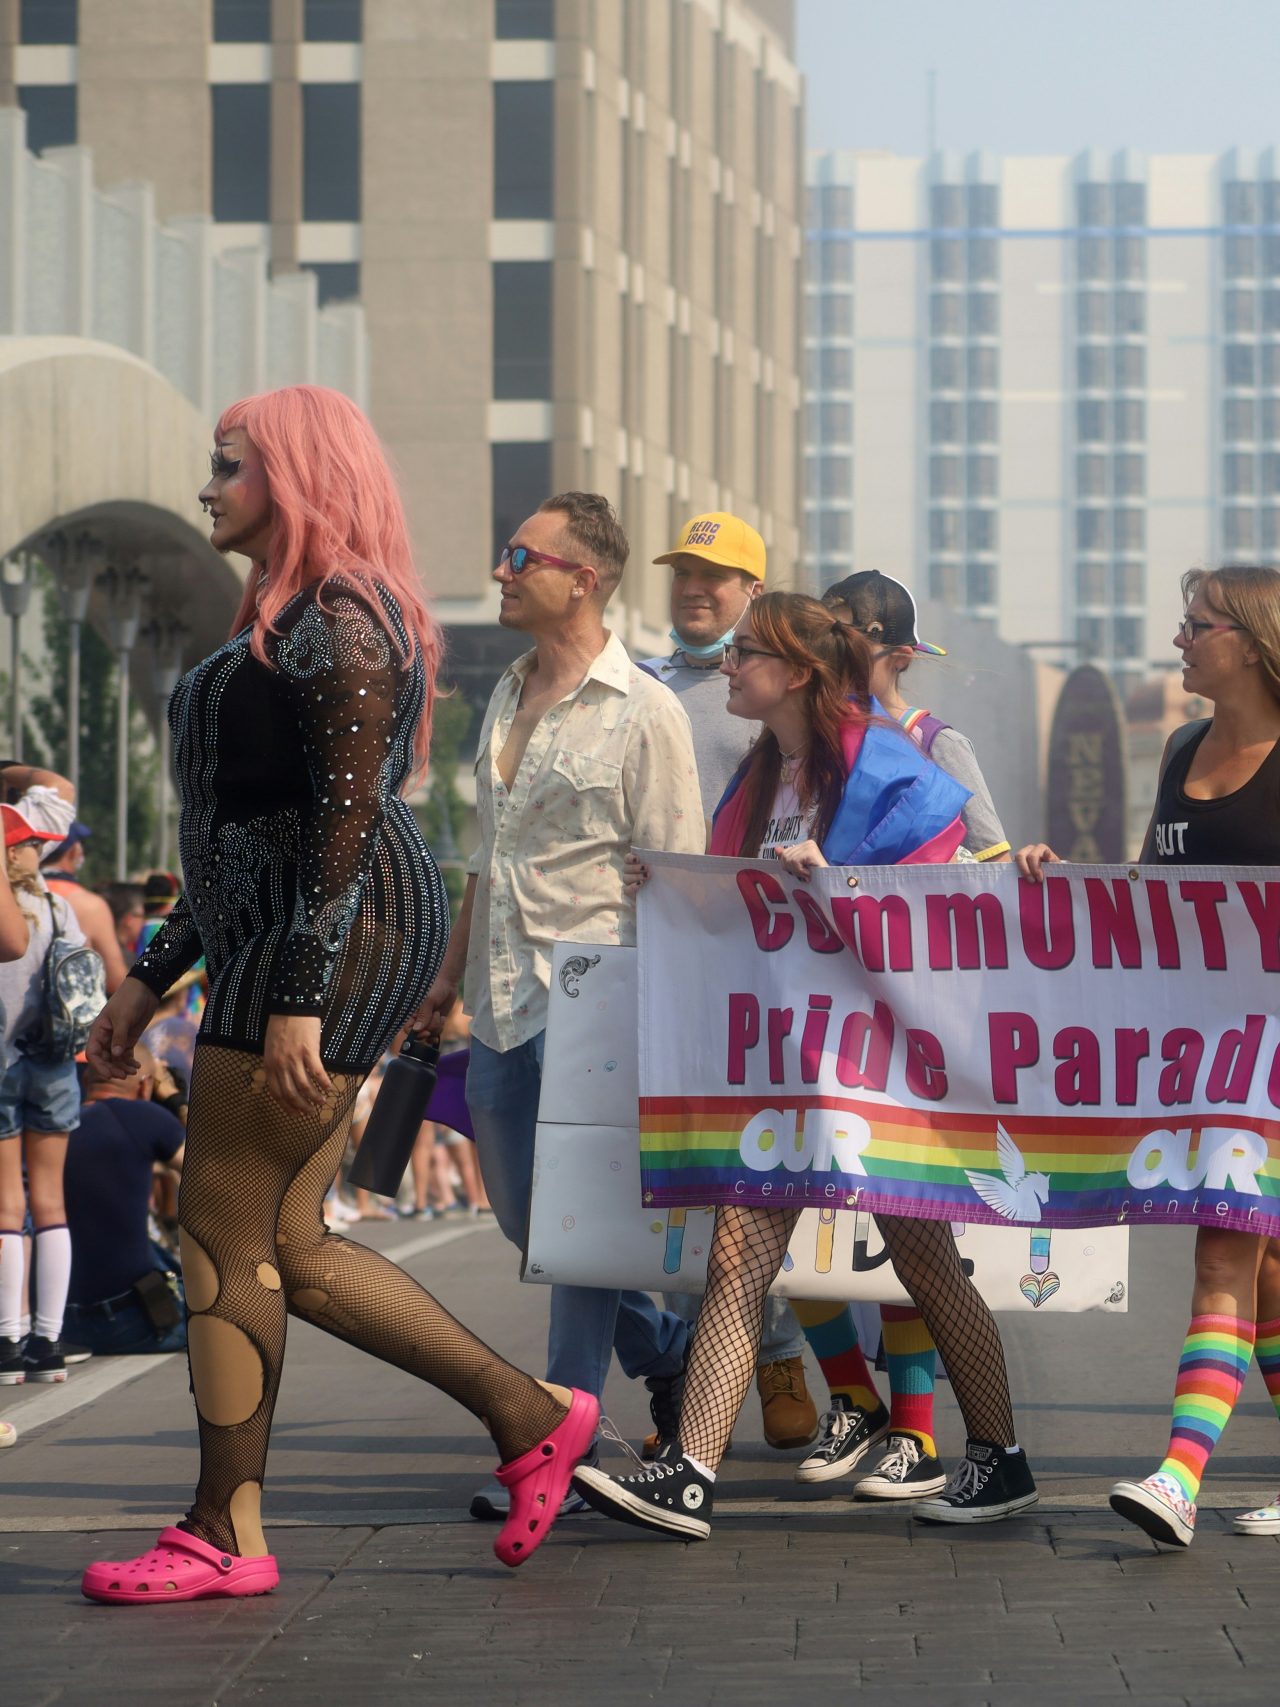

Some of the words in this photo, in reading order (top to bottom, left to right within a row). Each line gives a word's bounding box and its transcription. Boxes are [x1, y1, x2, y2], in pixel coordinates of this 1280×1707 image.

[685, 532, 716, 546] 1868
[1155, 822, 1189, 856] BUT
[727, 993, 948, 1101] Pride
[738, 1108, 872, 1177] OUR
[1127, 1127, 1269, 1196] OUR
[734, 1178, 868, 1202] center
[1121, 1196, 1260, 1218] center
